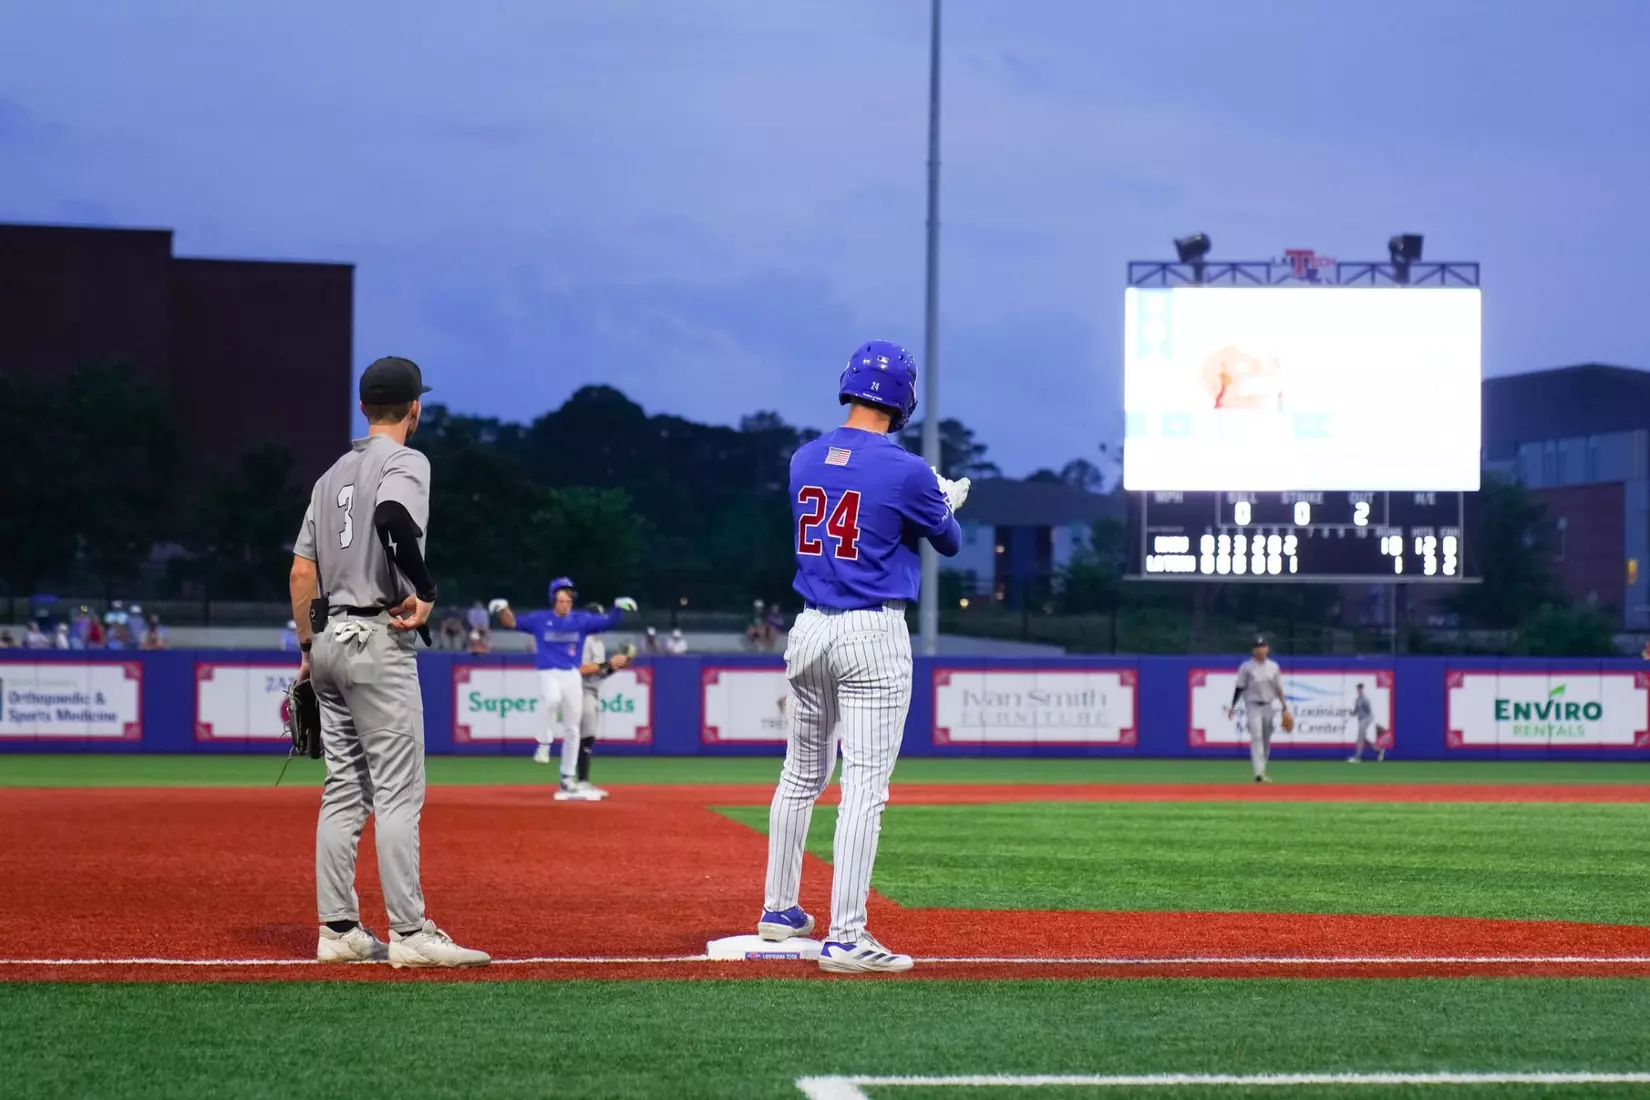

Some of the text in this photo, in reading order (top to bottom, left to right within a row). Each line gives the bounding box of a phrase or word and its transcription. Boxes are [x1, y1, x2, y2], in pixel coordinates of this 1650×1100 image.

[870, 381, 880, 391] 24
[336, 483, 354, 550] 3
[1234, 501, 1370, 526] 0 0 2
[797, 485, 861, 561] 24
[469, 691, 537, 718] Super
[963, 689, 1107, 707] Ivan Smith
[8, 709, 117, 726] Sports Medicine
[961, 711, 1108, 725] FURNITURE
[1294, 704, 1352, 717] Louisian
[1495, 699, 1602, 721] ENVIRO
[1300, 722, 1346, 734] Center
[1513, 724, 1585, 737] RENTALS
